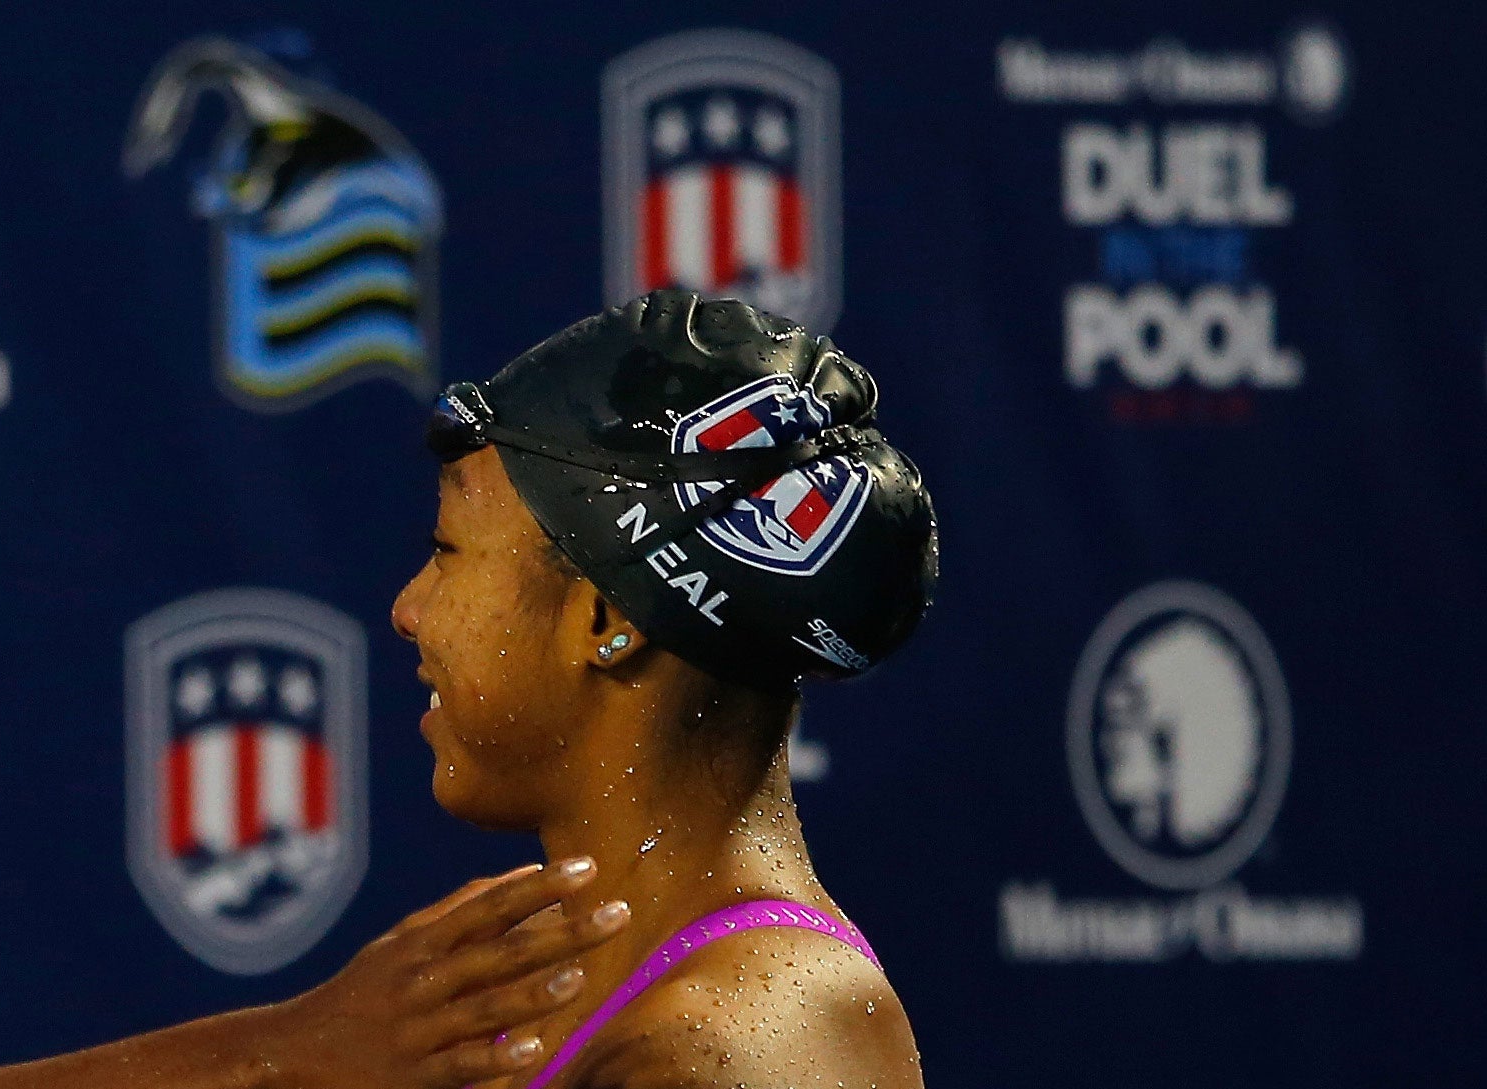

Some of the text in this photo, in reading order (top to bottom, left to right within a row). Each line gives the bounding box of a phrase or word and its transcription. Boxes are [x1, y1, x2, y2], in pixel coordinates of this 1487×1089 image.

[1063, 123, 1295, 226] DUEL
[1064, 286, 1305, 388] POOL
[616, 502, 730, 627] NEAL
